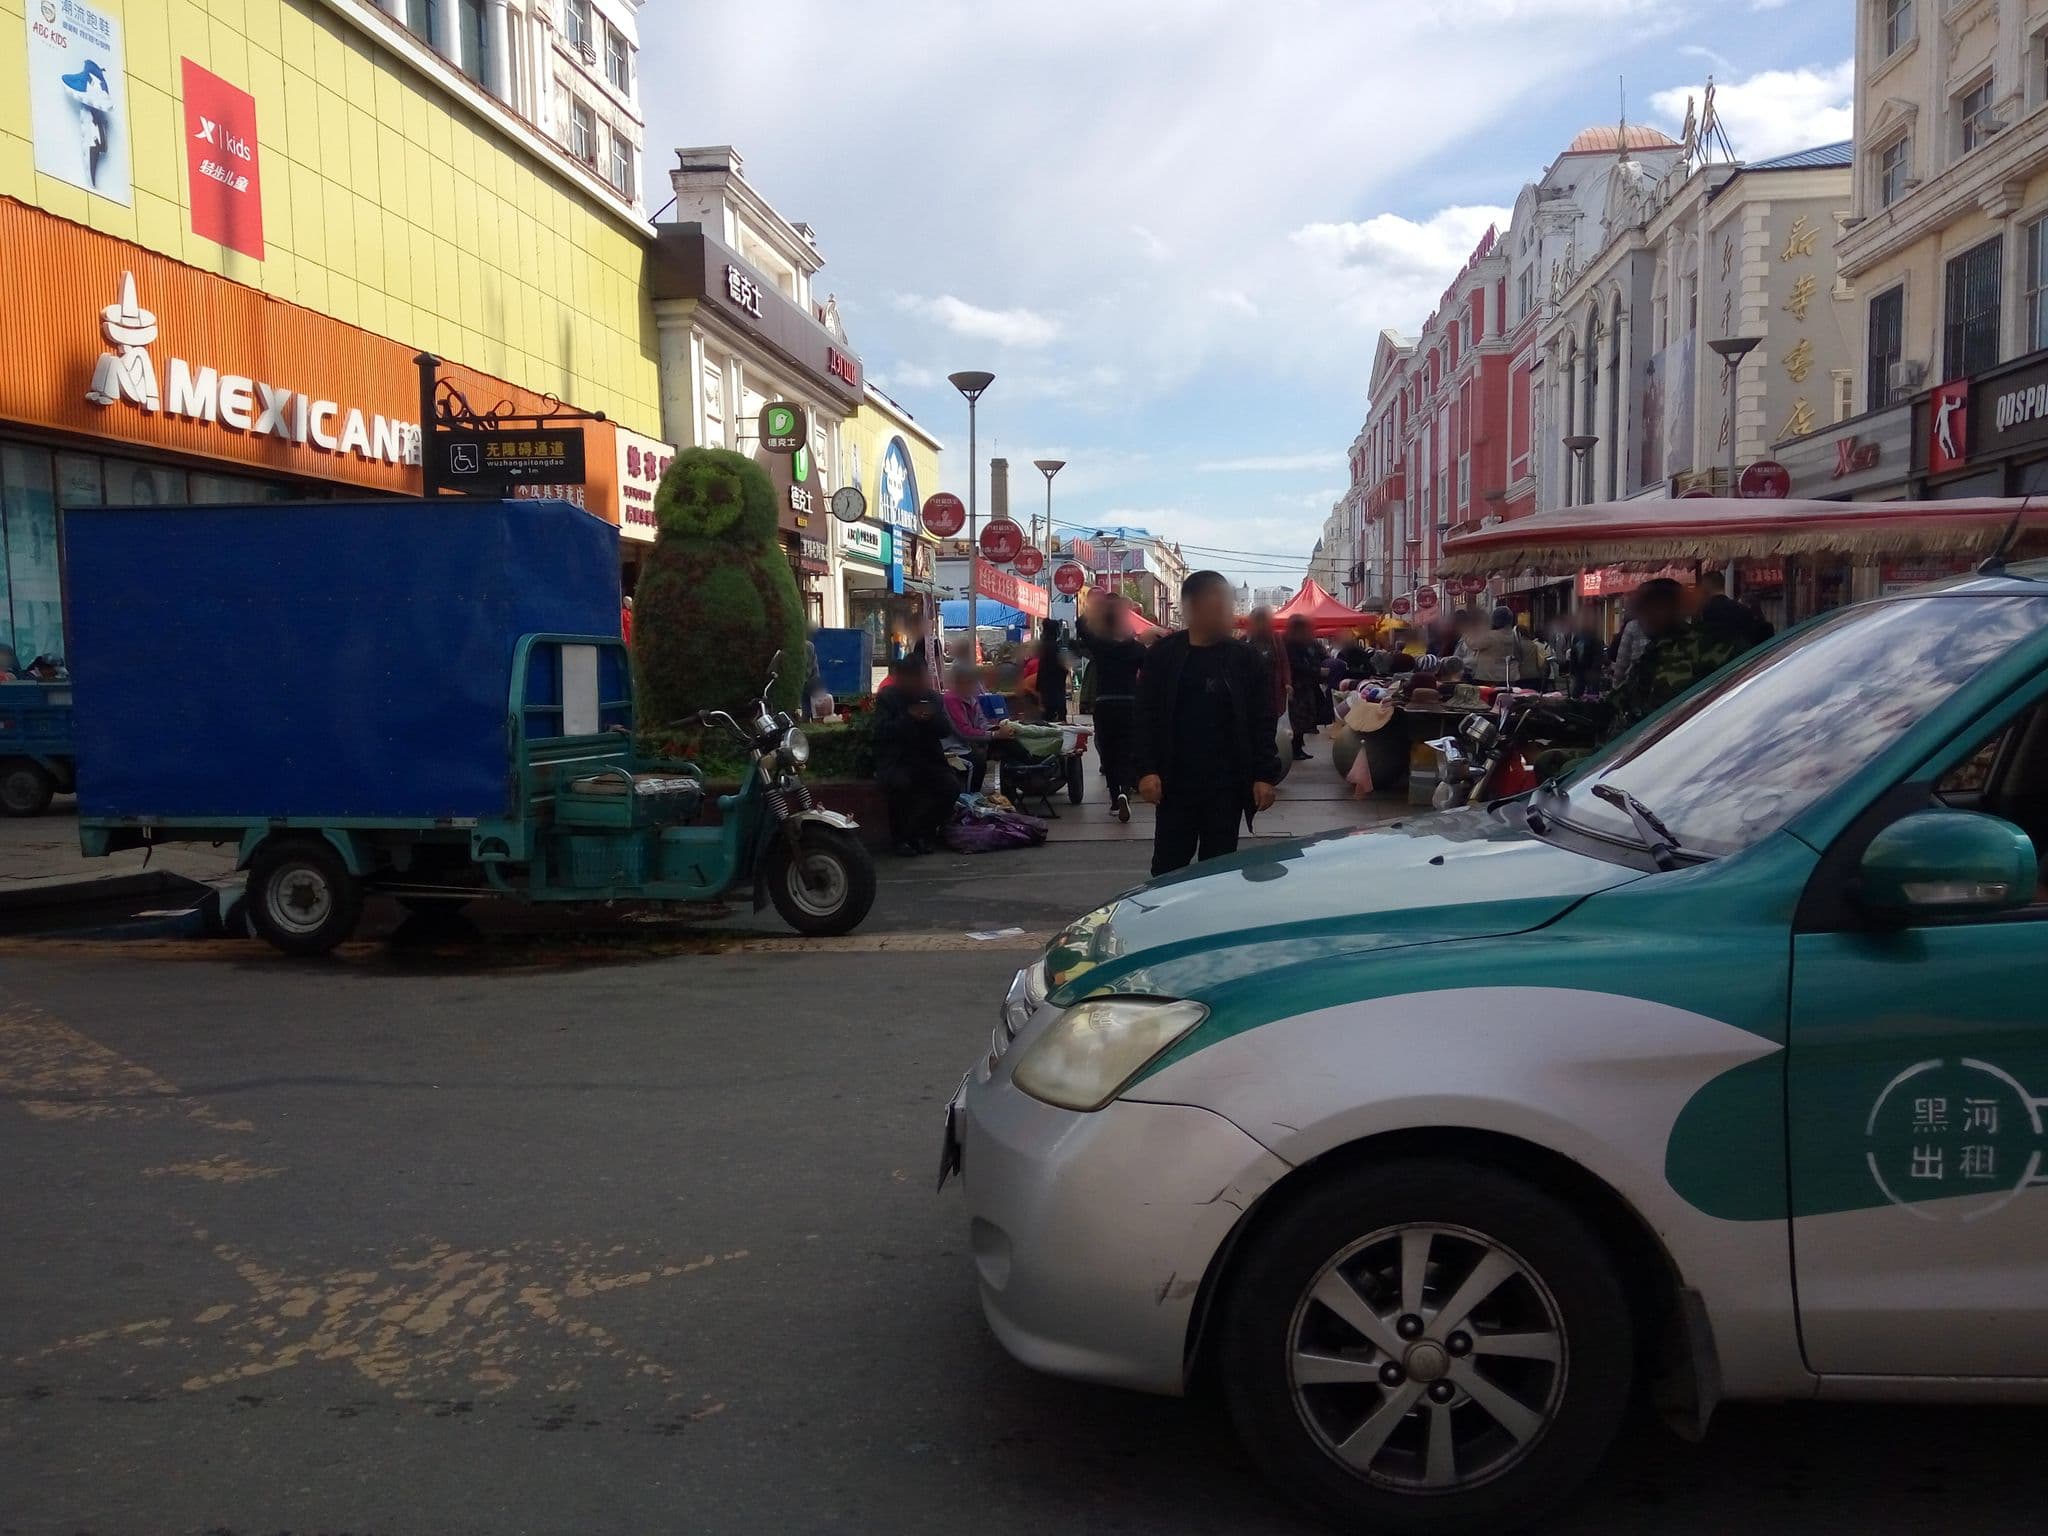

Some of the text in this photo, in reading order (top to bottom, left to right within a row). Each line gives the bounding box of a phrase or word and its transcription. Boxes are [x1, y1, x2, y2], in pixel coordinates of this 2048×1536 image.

[32, 21, 49, 39] ABC
[50, 30, 68, 49] KIDS
[225, 131, 251, 161] kids
[164, 357, 401, 464] MEXICAN
[486, 442, 564, 457] 无障碍通道
[1912, 1097, 2001, 1135] 黑河
[1911, 1143, 1998, 1180] 出租
